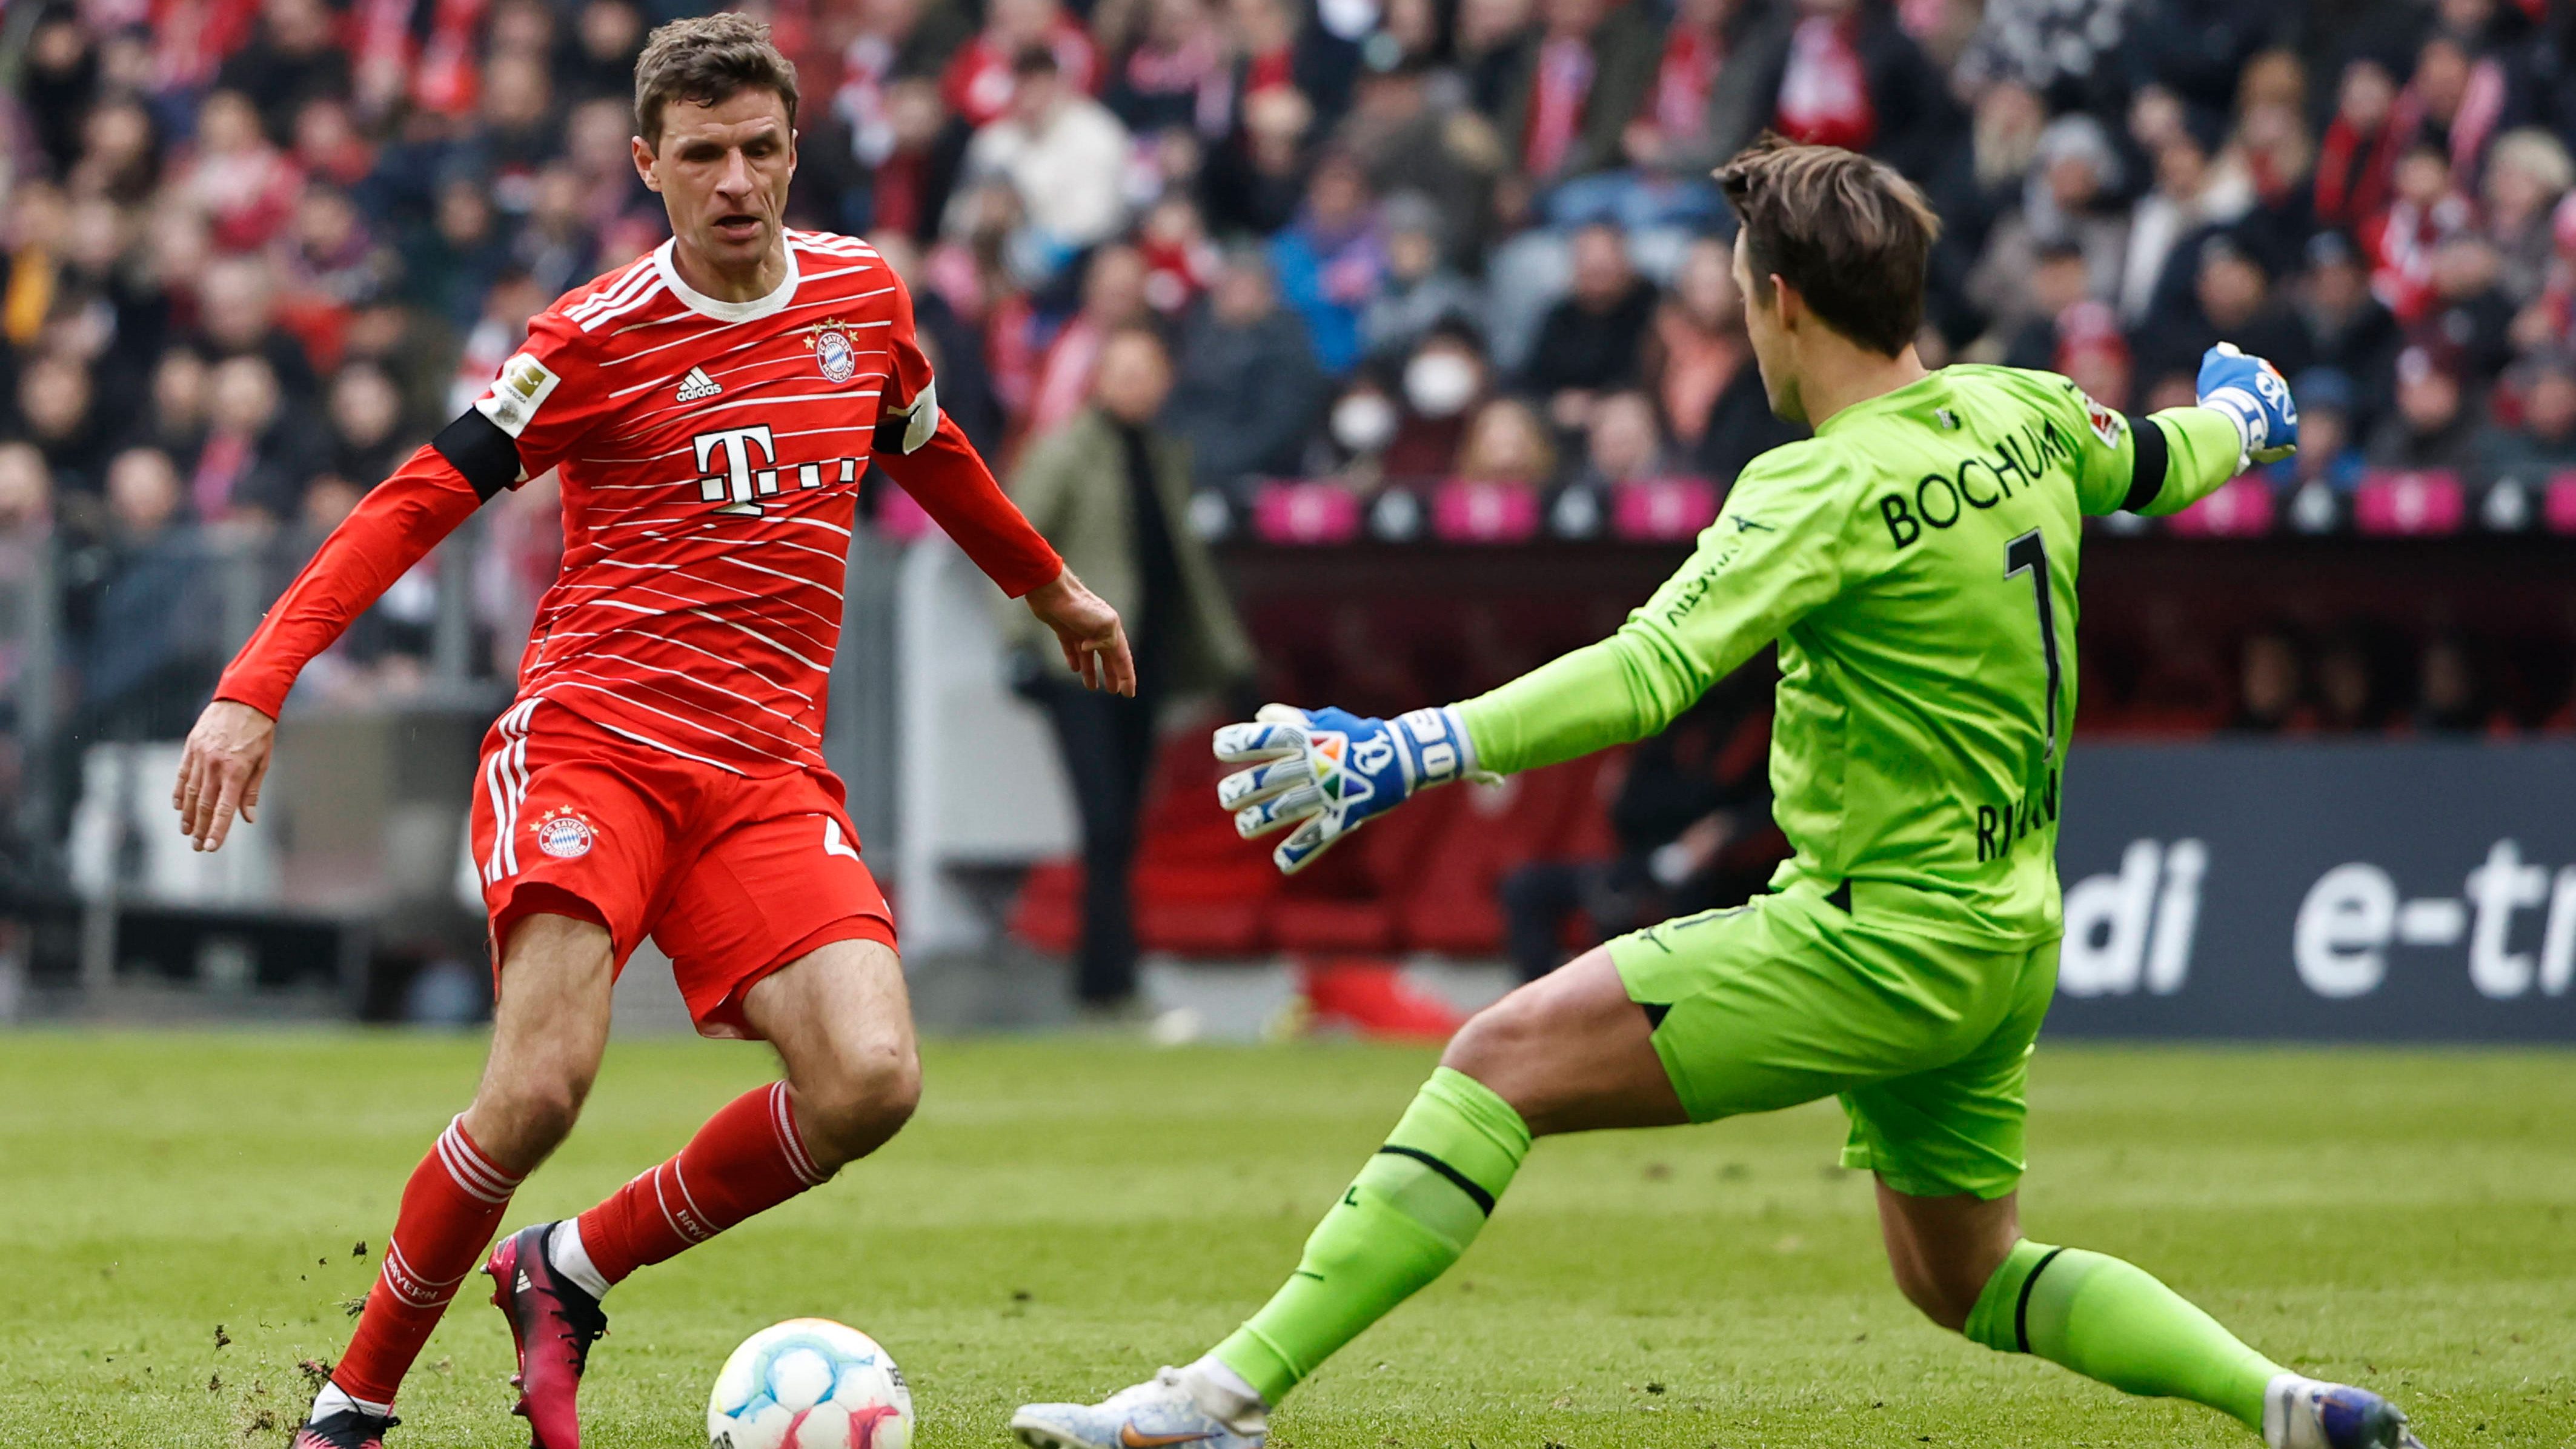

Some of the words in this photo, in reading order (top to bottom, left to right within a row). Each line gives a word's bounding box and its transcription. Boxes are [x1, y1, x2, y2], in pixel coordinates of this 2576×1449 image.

[819, 342, 826, 356] FC
[822, 335, 850, 353] BAYERN
[676, 383, 723, 402] adidas
[1879, 419, 2066, 549] BOCHUM
[2003, 527, 2061, 764] 1
[542, 825, 556, 838] FC
[553, 821, 588, 838] BAYERN
[387, 1252, 439, 1300] BAYERN
